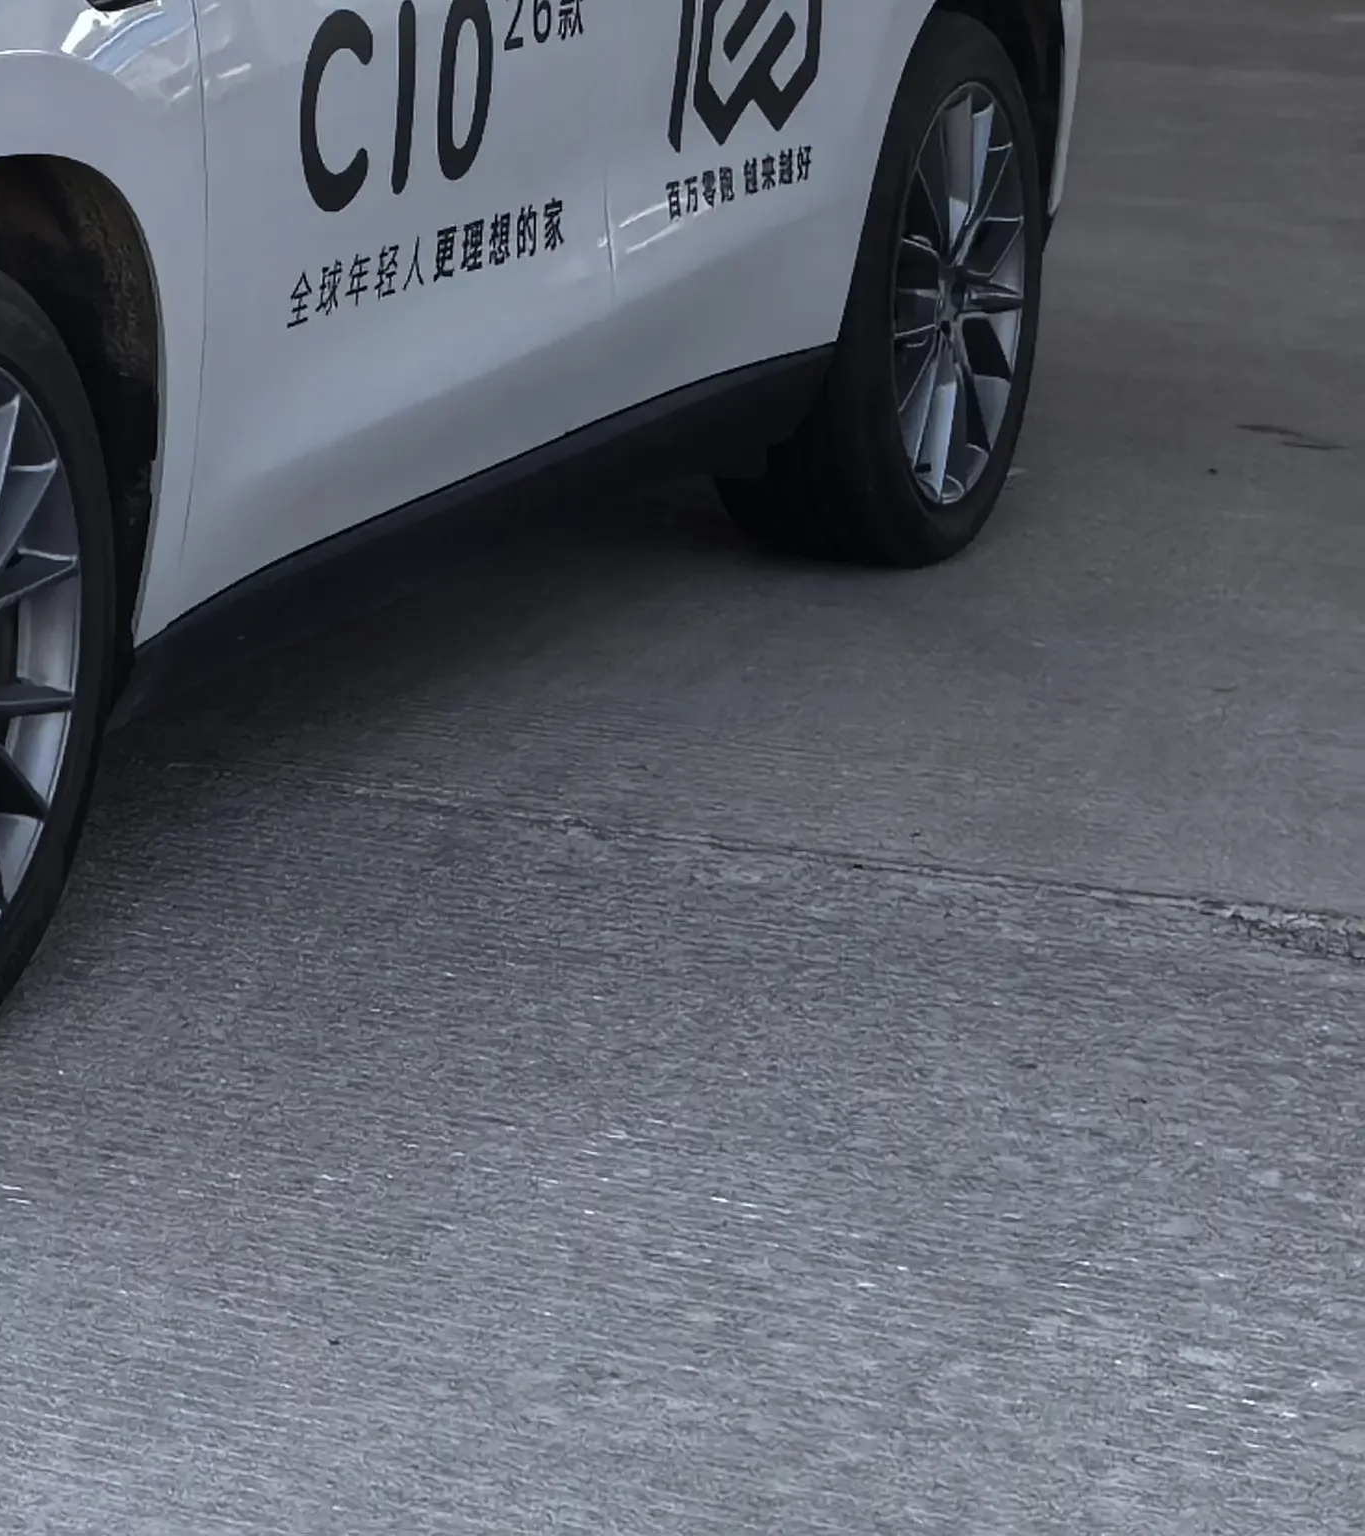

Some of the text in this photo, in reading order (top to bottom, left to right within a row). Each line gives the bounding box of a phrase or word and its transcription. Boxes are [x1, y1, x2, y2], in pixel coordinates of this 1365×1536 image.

[665, 145, 813, 220] 百万零跑 越来越好
[286, 197, 565, 329] 全球年轻人更理想的家
